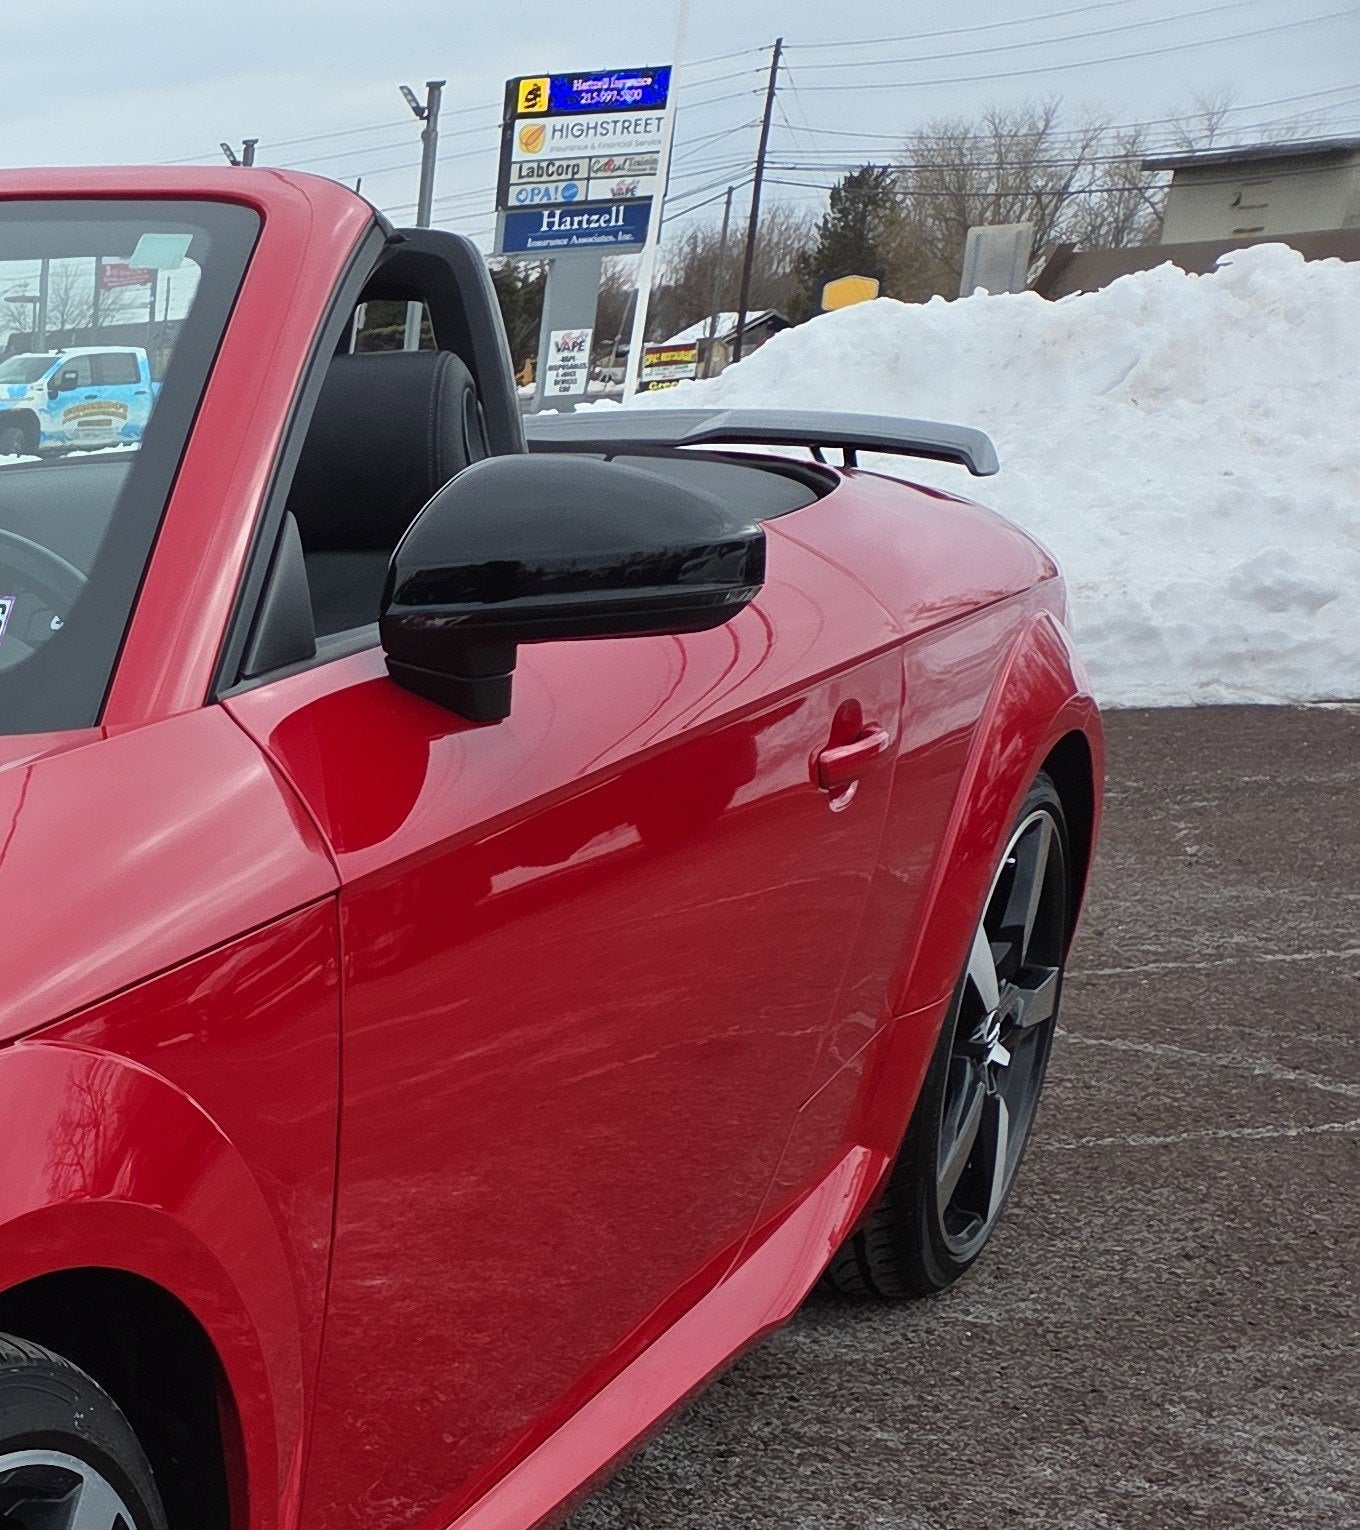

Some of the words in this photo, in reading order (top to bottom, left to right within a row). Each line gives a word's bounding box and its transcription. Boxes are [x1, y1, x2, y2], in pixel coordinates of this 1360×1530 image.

[551, 117, 665, 140] HIGHSTREET
[518, 161, 580, 180] LabCorp
[516, 184, 559, 203] OPA!
[540, 205, 624, 232] Hartzell
[526, 237, 569, 248] Insurance
[617, 230, 635, 242] Inc.
[555, 339, 586, 353] VAPE
